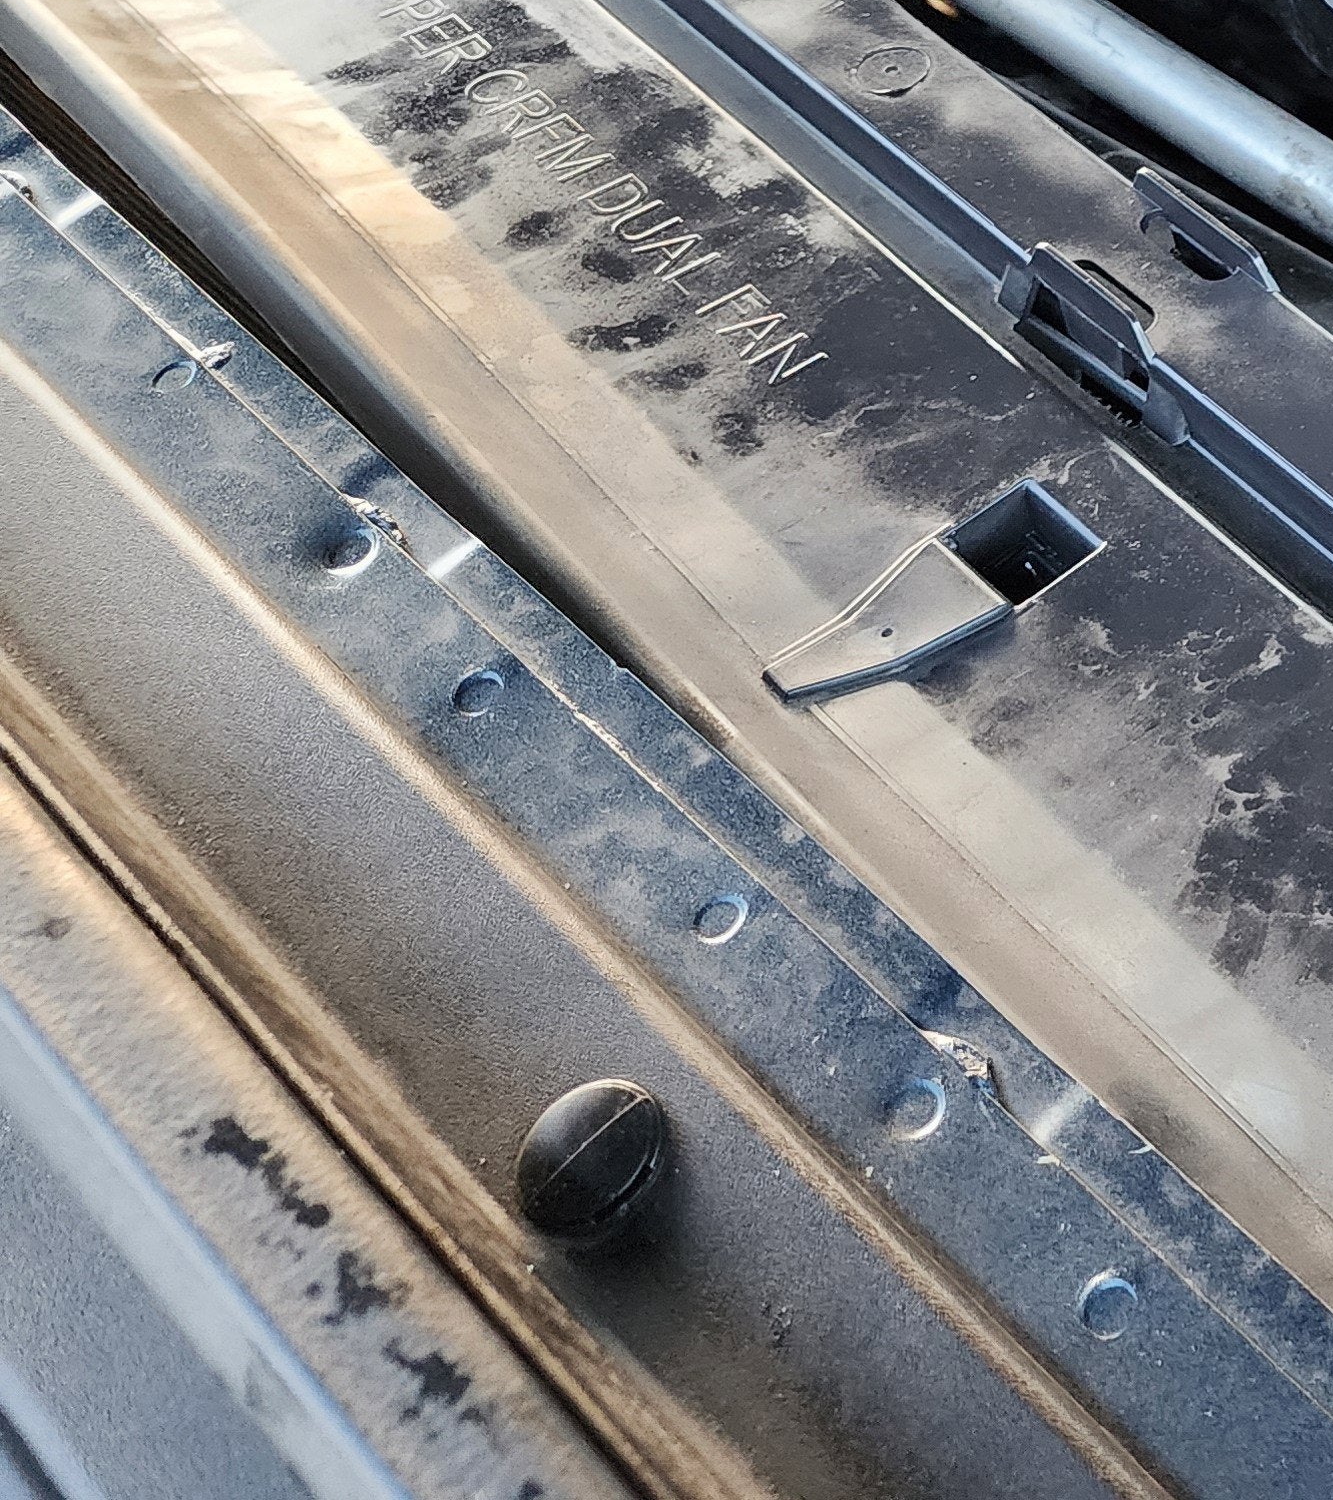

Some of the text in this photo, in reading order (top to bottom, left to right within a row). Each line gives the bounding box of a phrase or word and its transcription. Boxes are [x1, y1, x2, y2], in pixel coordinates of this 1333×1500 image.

[464, 69, 616, 182] CRFM
[578, 173, 722, 295] DUAL
[696, 284, 829, 385] FAN
